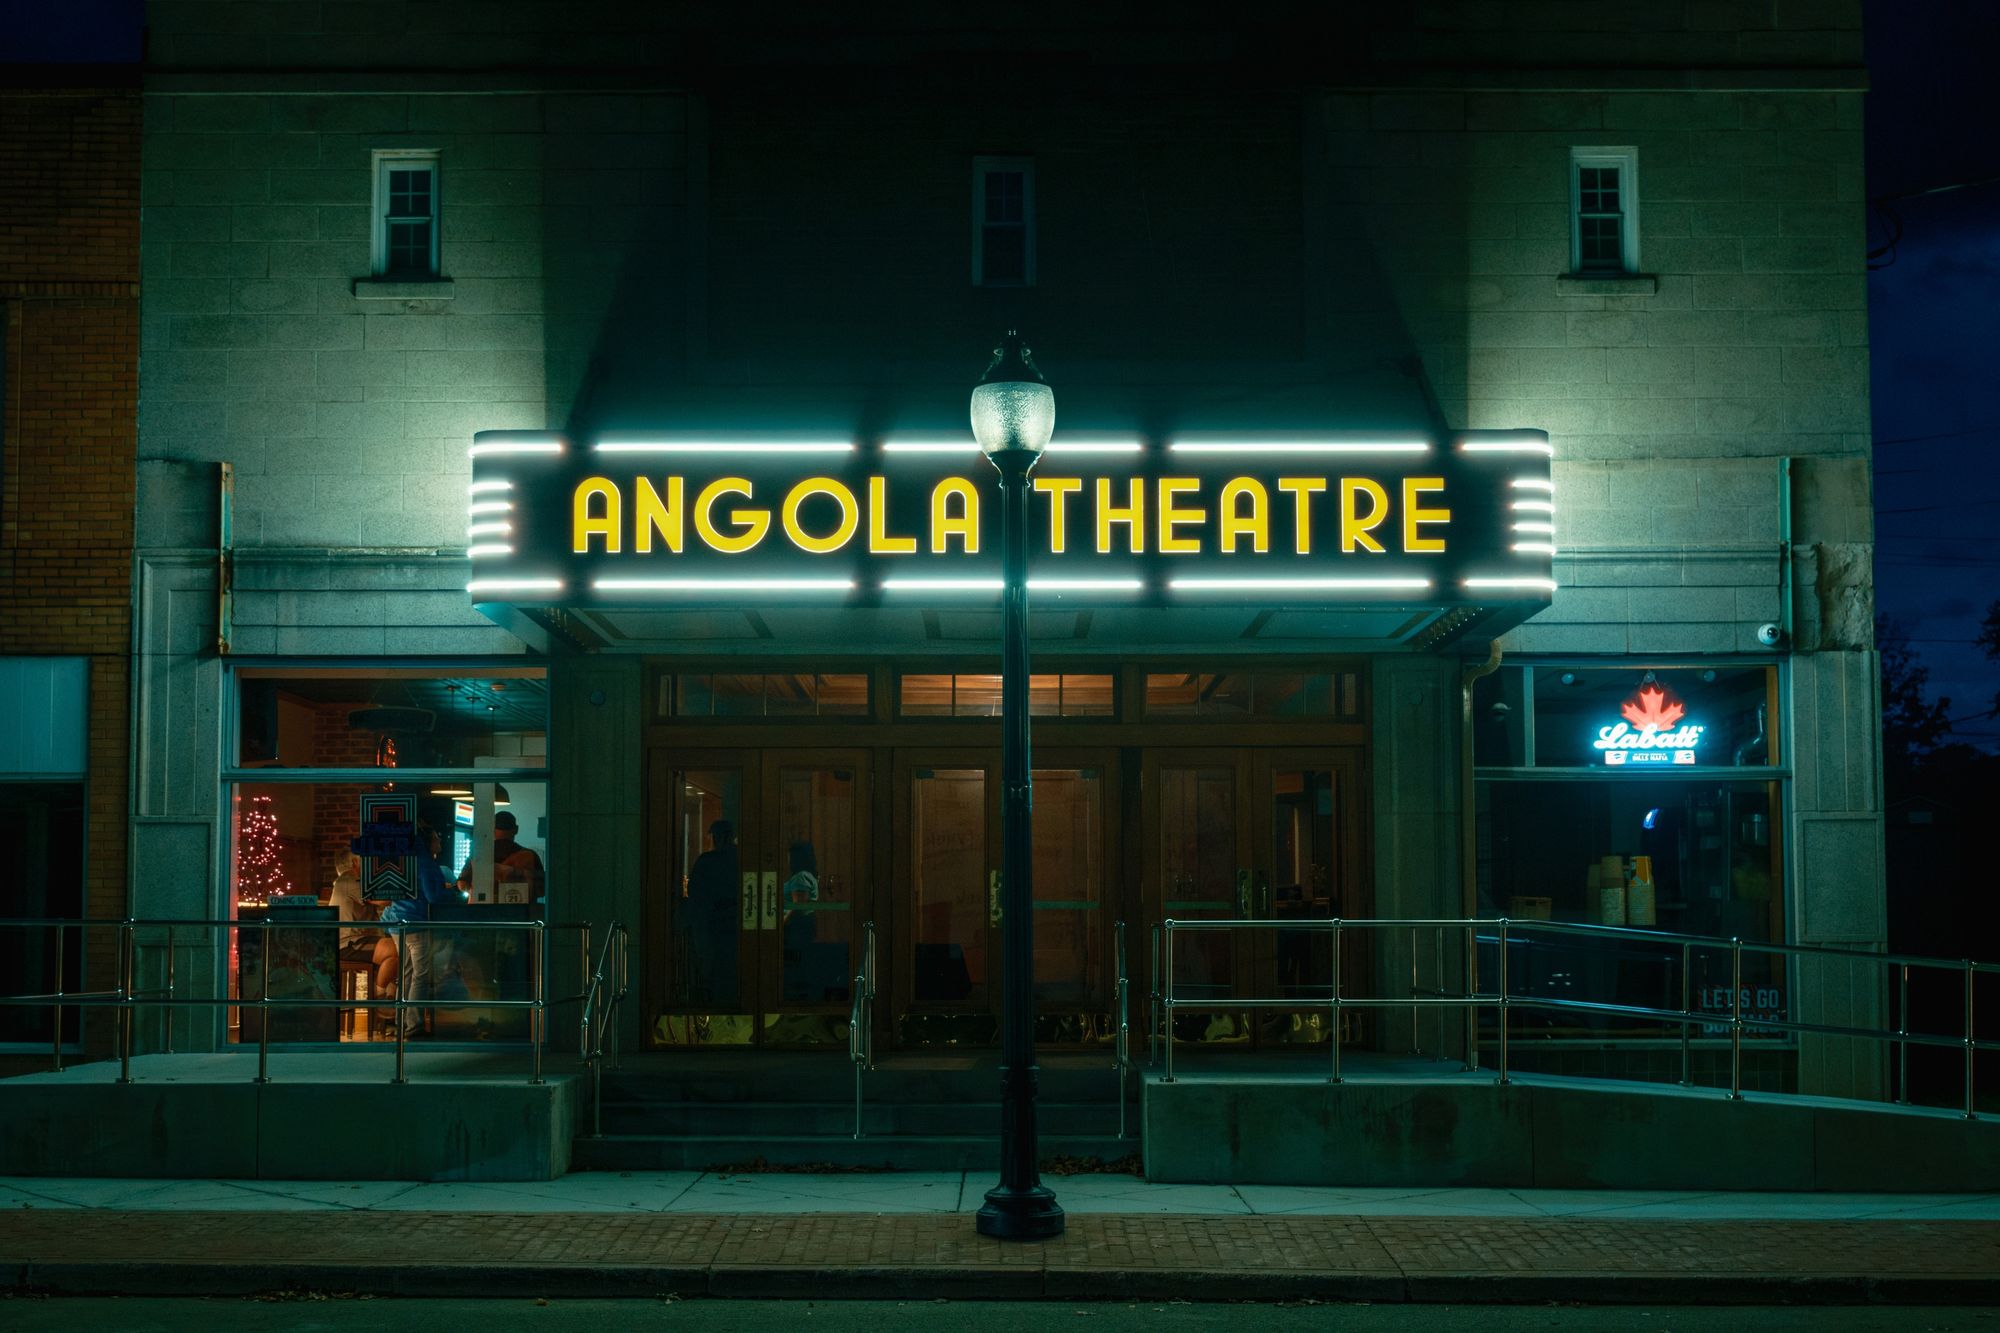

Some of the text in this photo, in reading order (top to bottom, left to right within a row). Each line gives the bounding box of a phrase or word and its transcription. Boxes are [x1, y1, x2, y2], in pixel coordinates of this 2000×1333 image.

[573, 476, 1451, 553] ANGOLA THEATRE
[1593, 722, 1700, 749] Labatt
[1702, 988, 1779, 1009] LETS GO
